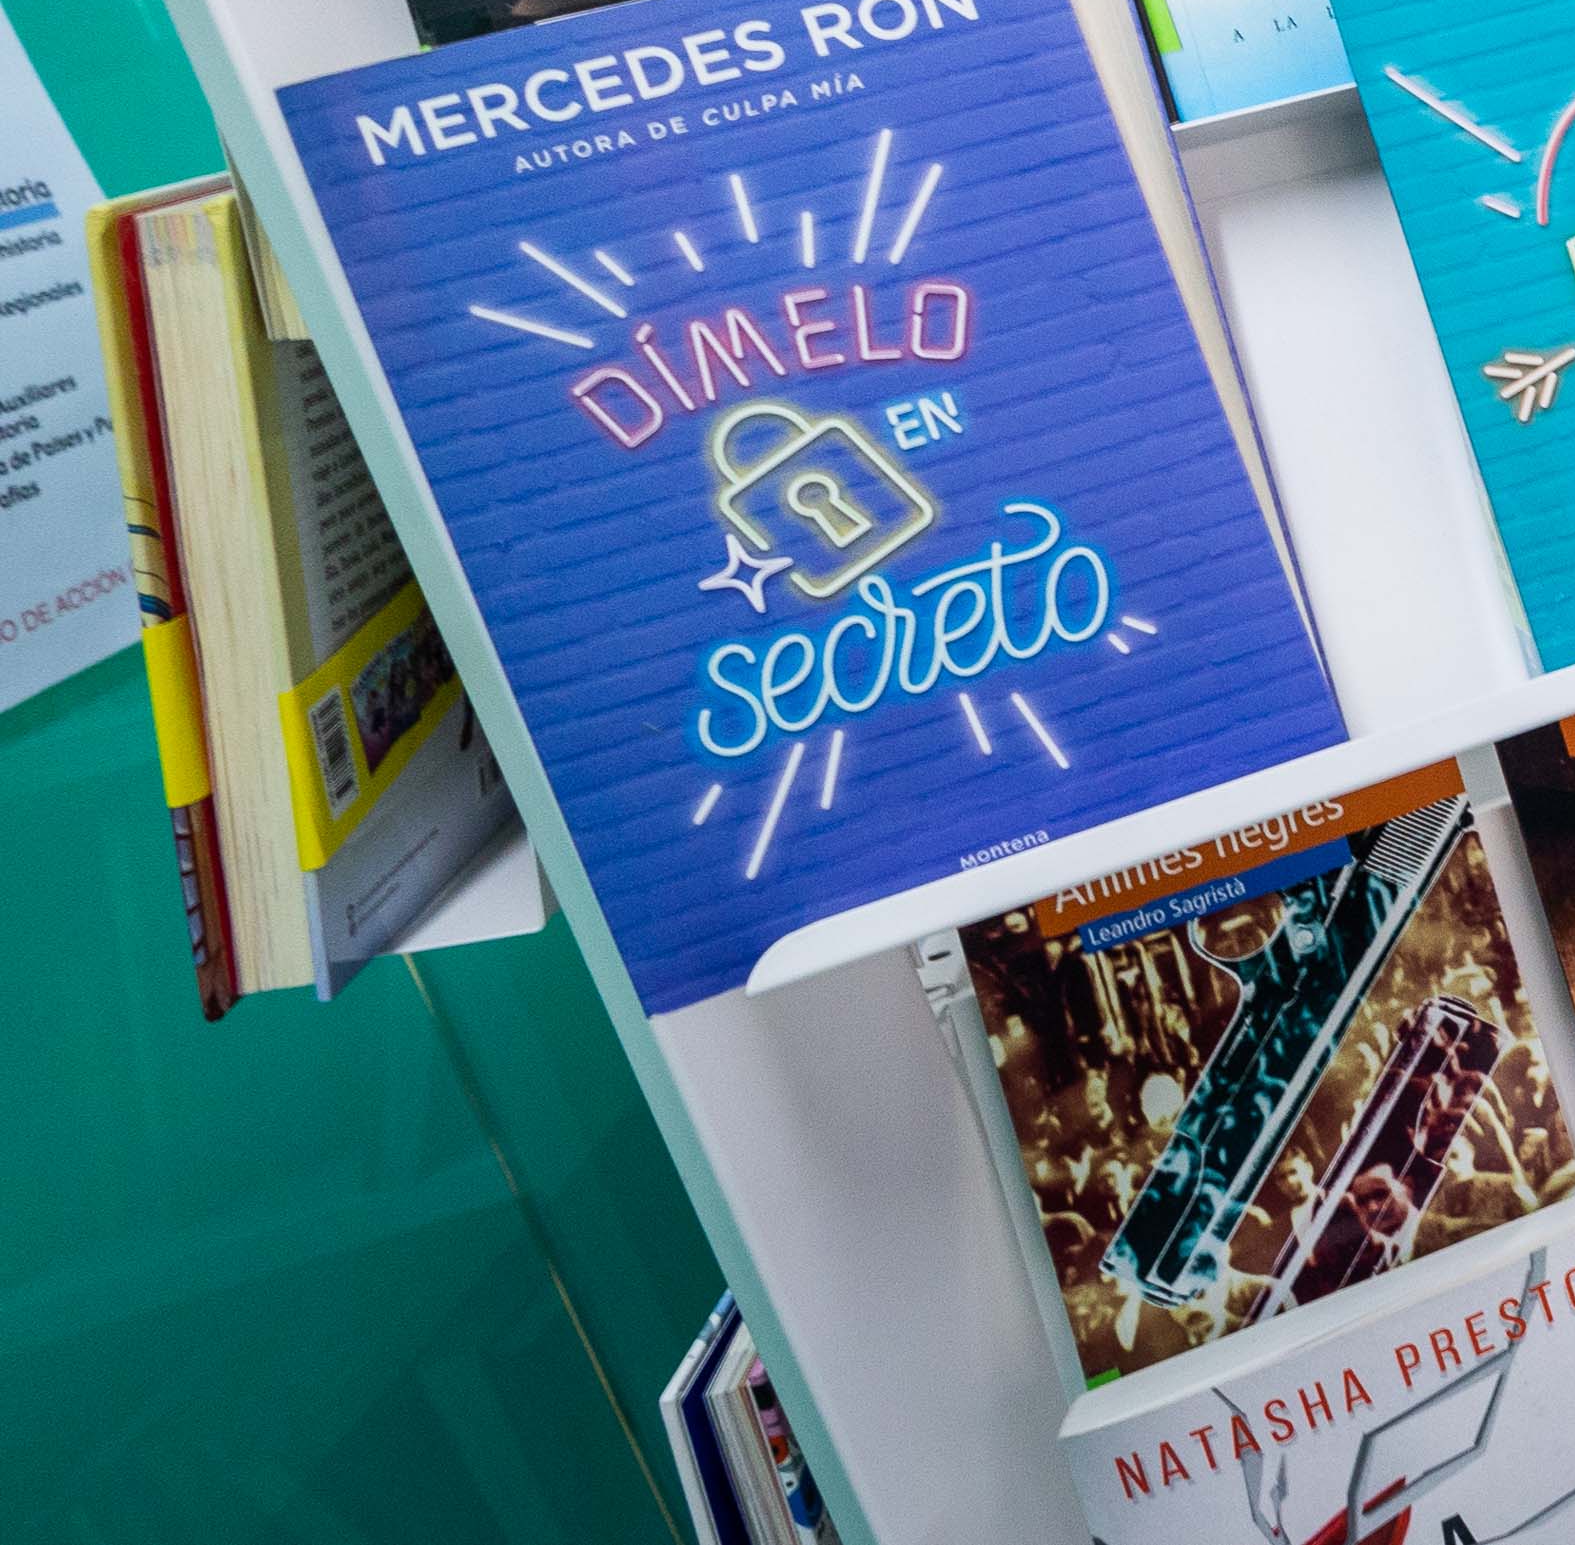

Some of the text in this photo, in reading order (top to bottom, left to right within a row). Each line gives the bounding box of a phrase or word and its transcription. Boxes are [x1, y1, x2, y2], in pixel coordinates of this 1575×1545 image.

[1272, 14, 1298, 33] LA
[355, 18, 787, 167] MERCEDES
[513, 72, 867, 176] AUTORA DE CULPA MÍA
[571, 281, 969, 450] DÍMELO
[888, 389, 961, 452] EN
[695, 500, 1110, 760] secreto
[960, 828, 1052, 872] Montena
[1087, 876, 1247, 949] Leandro Sagristà
[1114, 1366, 1374, 1501] NATASHA
